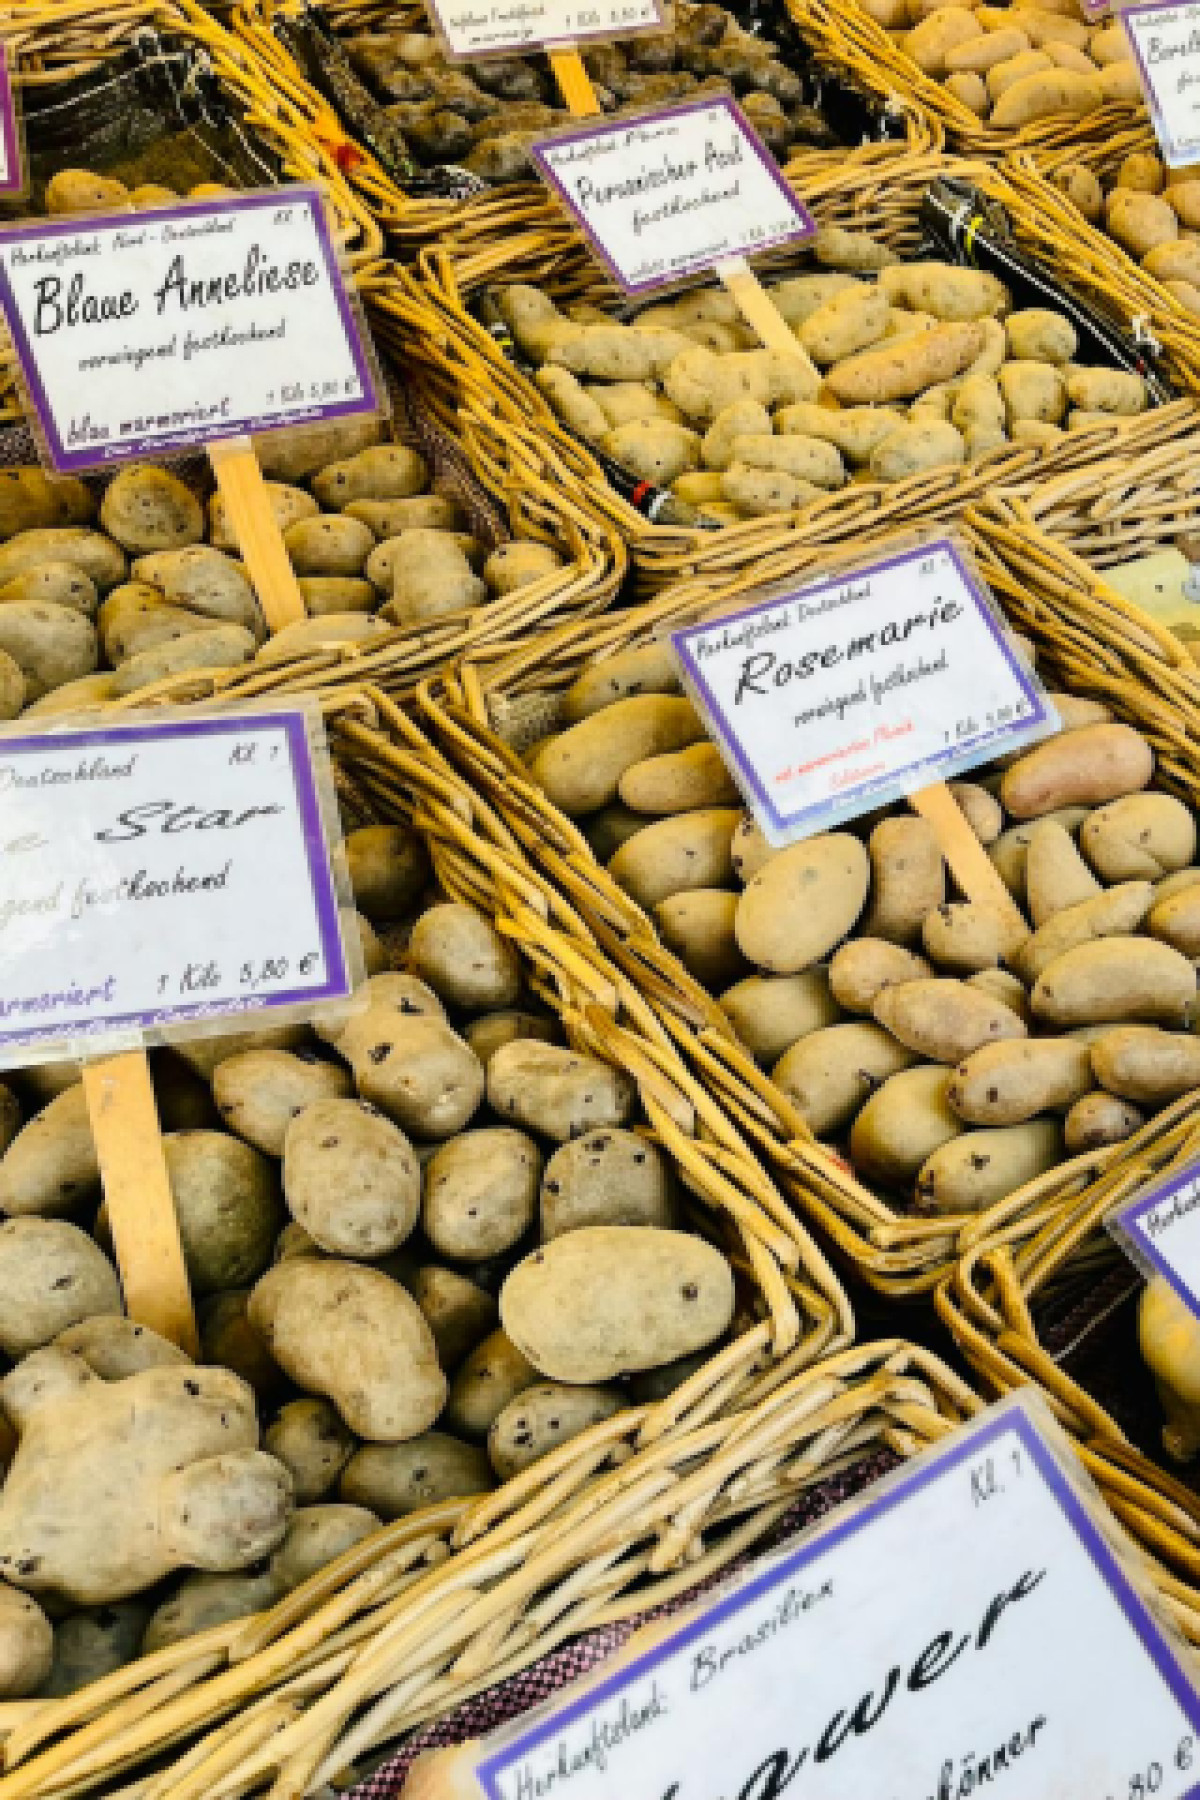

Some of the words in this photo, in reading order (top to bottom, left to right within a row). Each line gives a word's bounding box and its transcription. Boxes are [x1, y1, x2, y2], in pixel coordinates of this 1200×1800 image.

[34, 273, 138, 337] Blaue
[154, 243, 319, 315] Anneliese
[184, 318, 286, 361] festkochend
[735, 594, 964, 705] Rosemarie
[869, 647, 949, 706] festkochend
[94, 799, 286, 843] Star
[157, 973, 169, 995] 1
[179, 960, 222, 993] Kilo
[298, 951, 320, 976] €
[689, 1578, 834, 1693] Brasilien
[1012, 1450, 1021, 1478] 1
[1173, 1735, 1194, 1771] €
